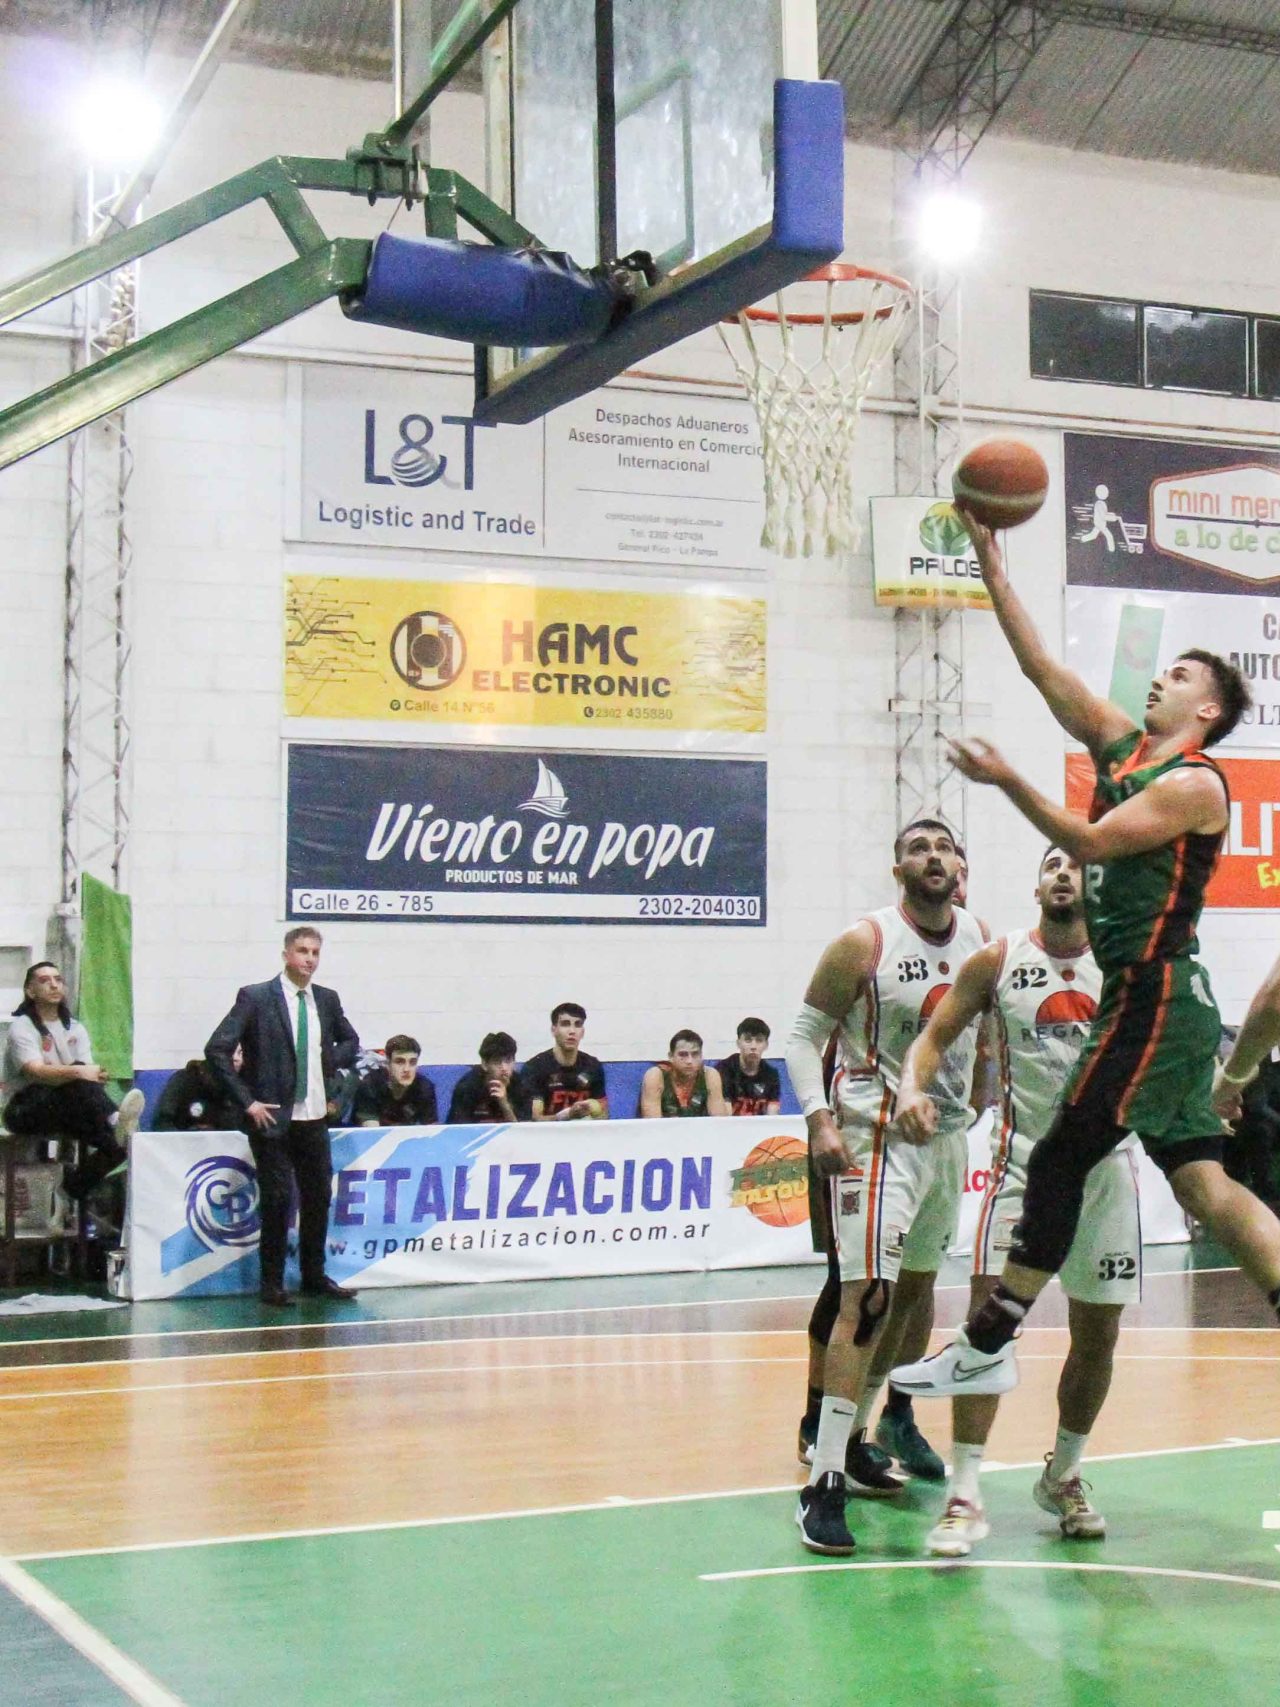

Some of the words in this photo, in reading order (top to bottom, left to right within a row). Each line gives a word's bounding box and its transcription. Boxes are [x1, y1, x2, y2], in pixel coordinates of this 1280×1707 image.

[595, 408, 671, 428] Despachos
[676, 416, 749, 434] Aduaneros
[364, 409, 498, 491] L&T
[568, 427, 673, 449] Asesoramiento
[678, 439, 695, 450] en
[618, 453, 710, 473] Internacional
[1168, 488, 1221, 515] mini
[318, 500, 414, 530] Logistic
[422, 508, 465, 531] and
[473, 511, 536, 537] Trade
[1174, 527, 1189, 547] a
[1197, 524, 1221, 550] lo
[1229, 526, 1258, 552] de
[910, 556, 982, 579] PALOS
[502, 619, 639, 667] HAMC
[472, 669, 671, 698] ELECTRONIC
[404, 699, 439, 712] Calle
[366, 801, 523, 866] Viento
[532, 822, 589, 867] en
[588, 820, 716, 881] popa
[445, 868, 524, 885] PRODUCTOS
[527, 871, 545, 885] DE
[547, 871, 579, 886] MAR
[298, 892, 350, 912] Calle
[355, 893, 380, 912] 26
[399, 895, 434, 913] 785
[638, 897, 758, 917] 2302-204030
[897, 957, 929, 983] 33
[1011, 966, 1049, 990] 32
[334, 1156, 713, 1227] ETALIZACION
[1099, 1256, 1137, 1281] 32
